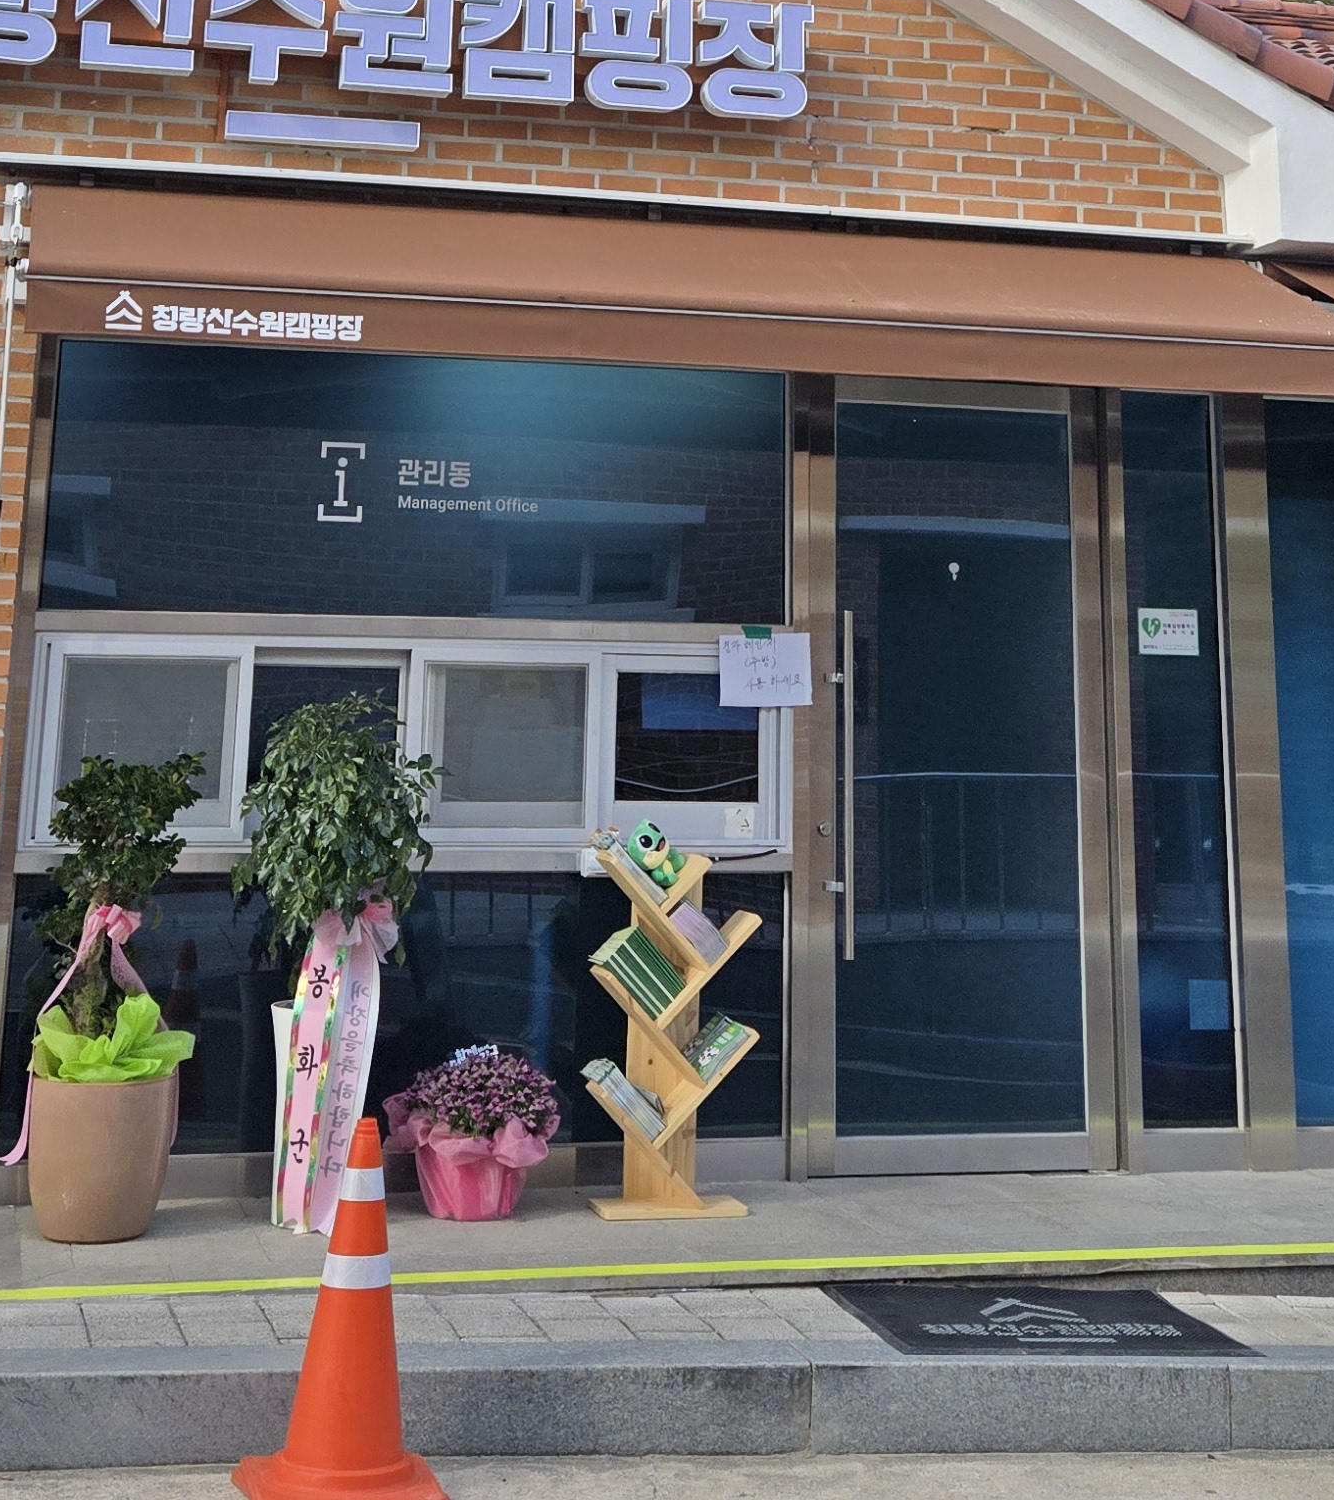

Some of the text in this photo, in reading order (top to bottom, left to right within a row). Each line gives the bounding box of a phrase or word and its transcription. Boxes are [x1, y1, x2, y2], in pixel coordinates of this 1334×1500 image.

[152, 304, 364, 342] 청량산수원캠핑장
[397, 458, 472, 488] 관리동
[397, 495, 539, 513] Management Office
